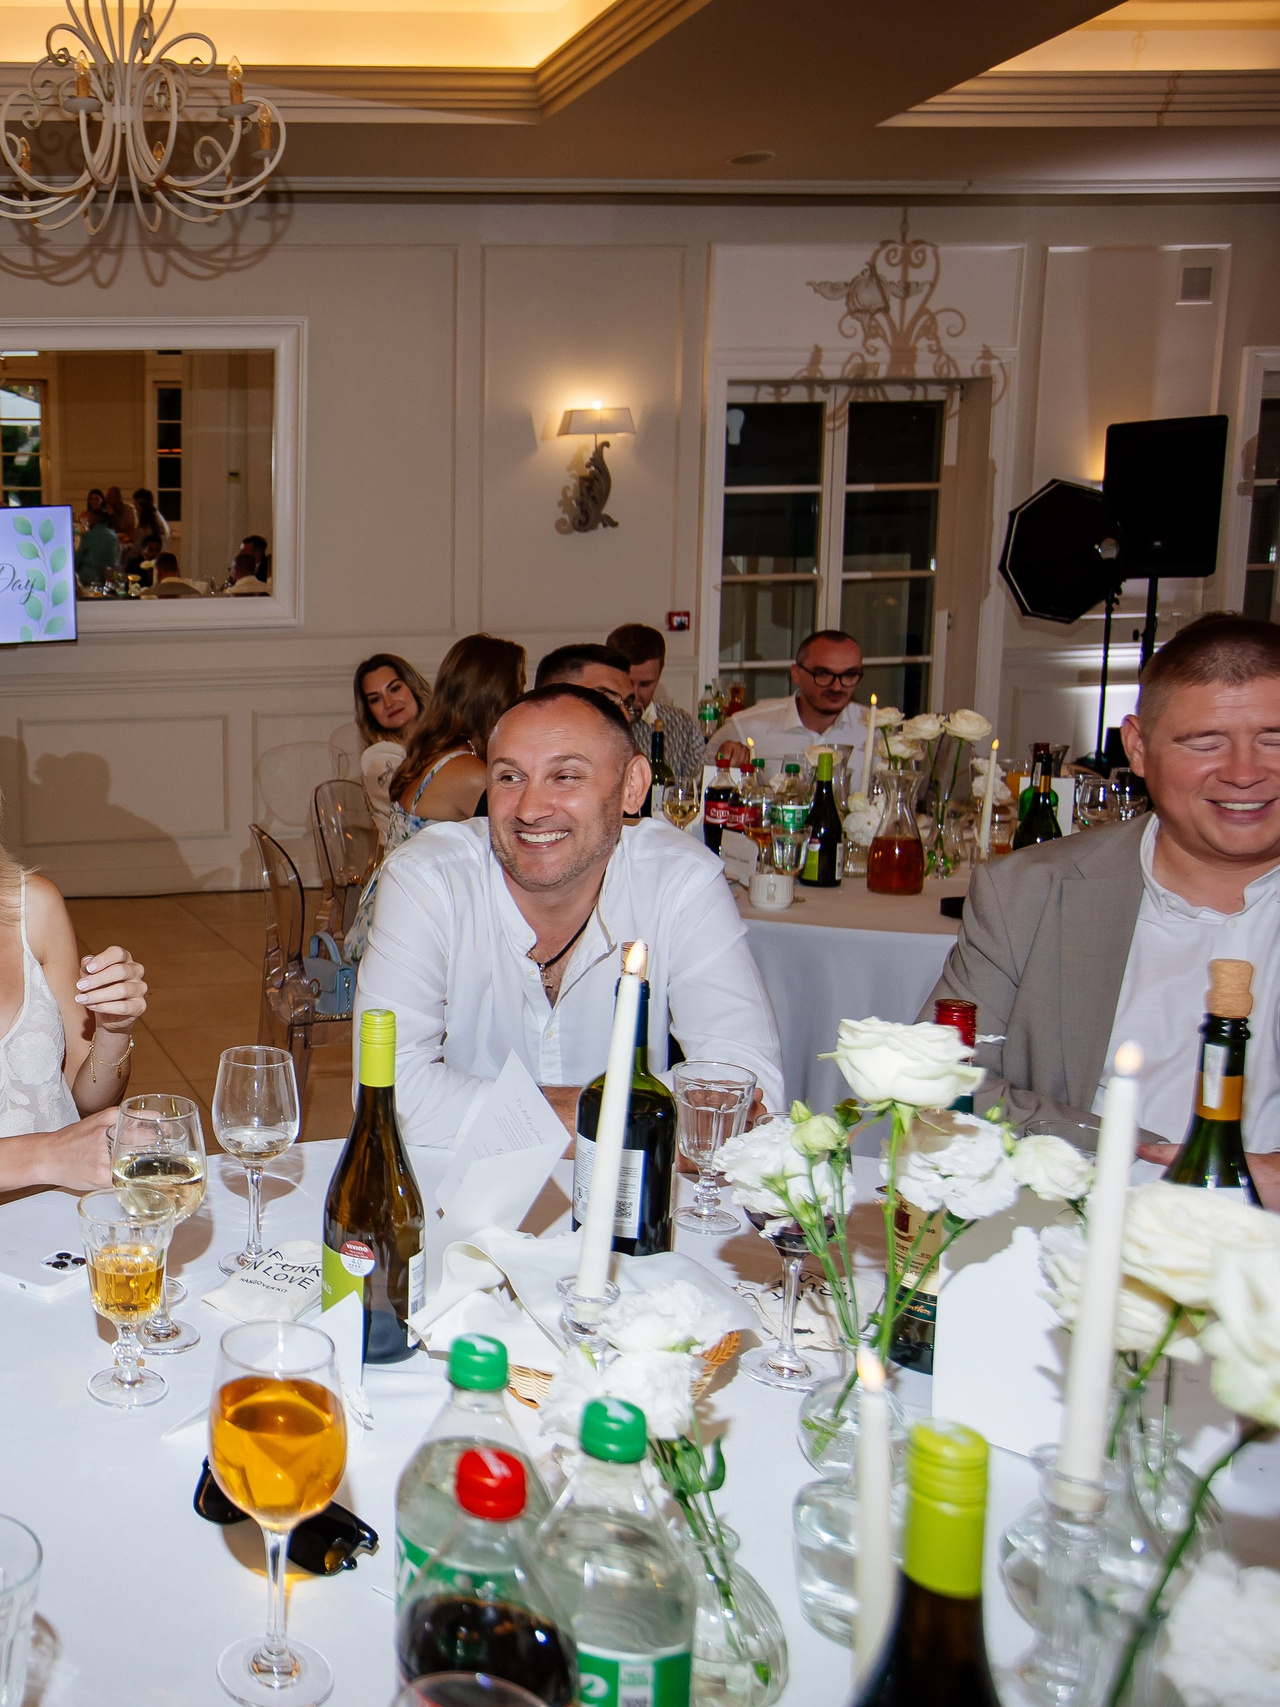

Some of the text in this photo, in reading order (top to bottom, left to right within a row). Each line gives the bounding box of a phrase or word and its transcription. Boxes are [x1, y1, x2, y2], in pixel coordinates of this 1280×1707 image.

[918, 1225, 936, 1234] 180
[895, 1242, 931, 1260] DISTED
[239, 1277, 275, 1290] HANGOVER
[262, 1266, 315, 1290] LOVE
